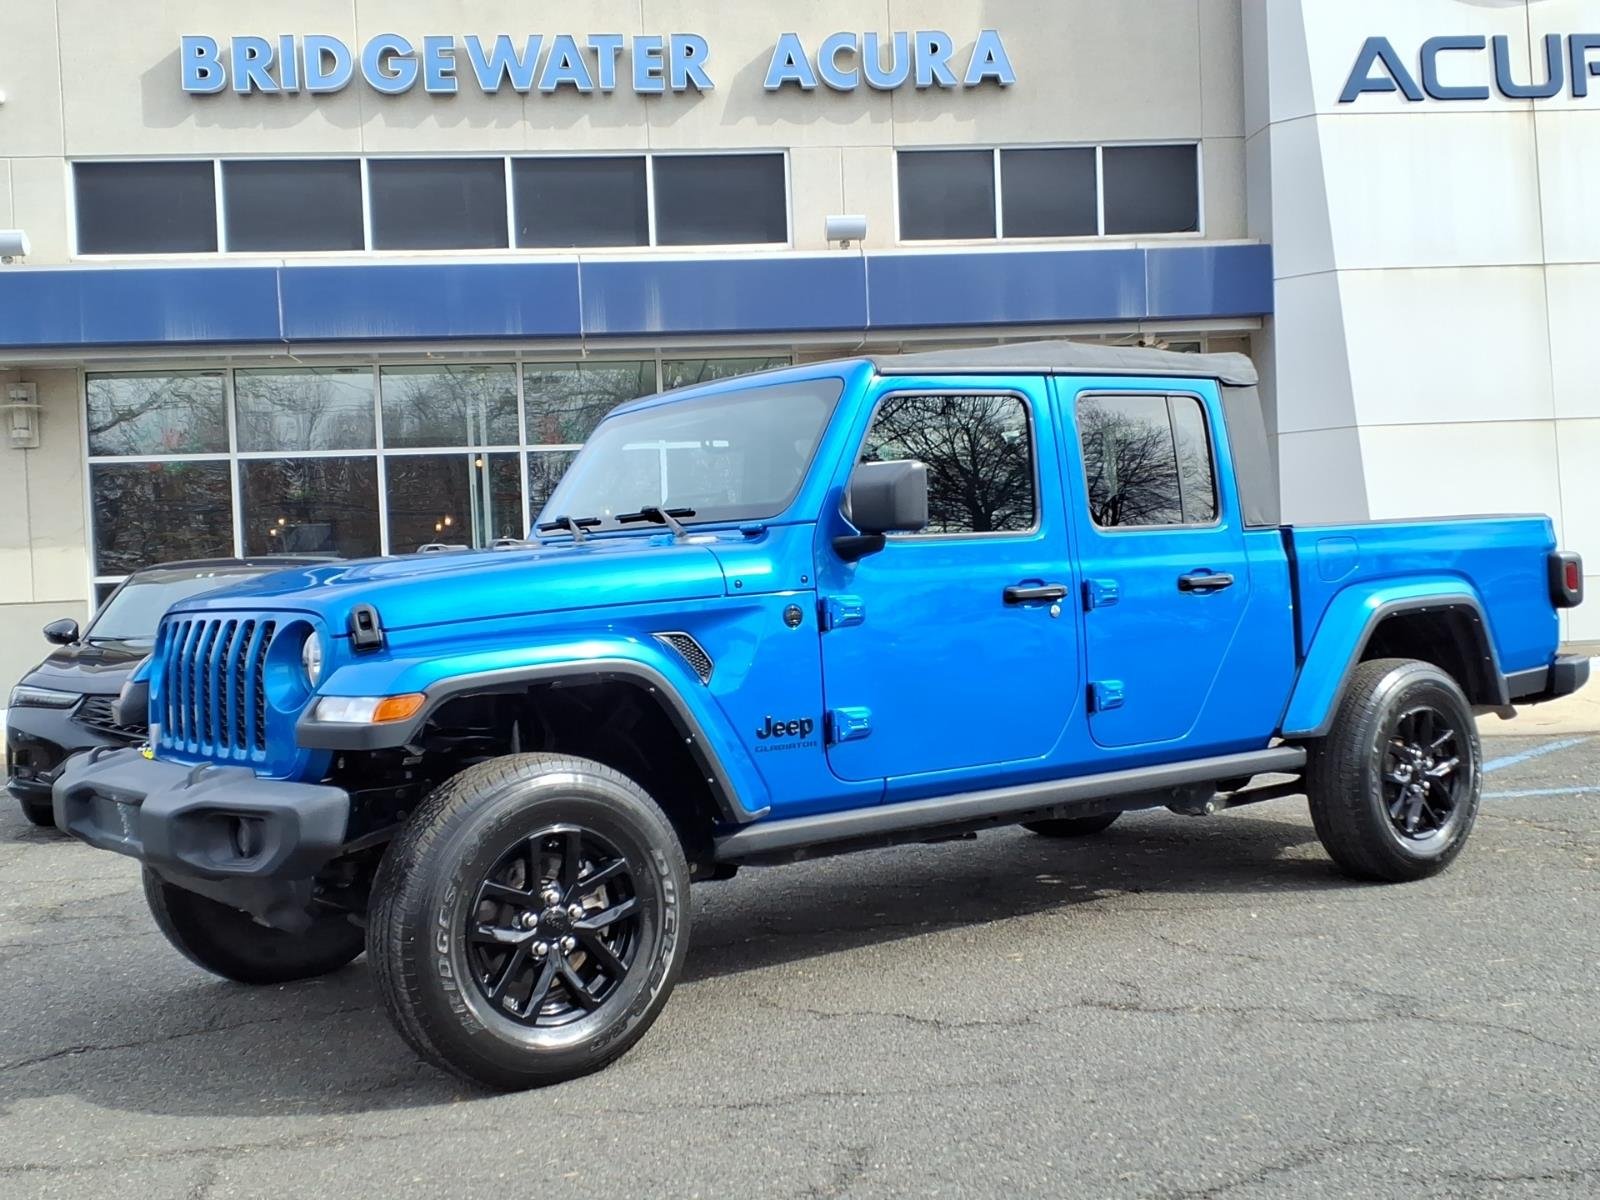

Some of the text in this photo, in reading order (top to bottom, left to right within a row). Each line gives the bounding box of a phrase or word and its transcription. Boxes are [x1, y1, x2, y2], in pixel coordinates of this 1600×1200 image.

[180, 29, 1017, 95] BRIDGEWATER ACURA
[756, 715, 815, 739] Jeep
[755, 741, 817, 753] GLADIATOR
